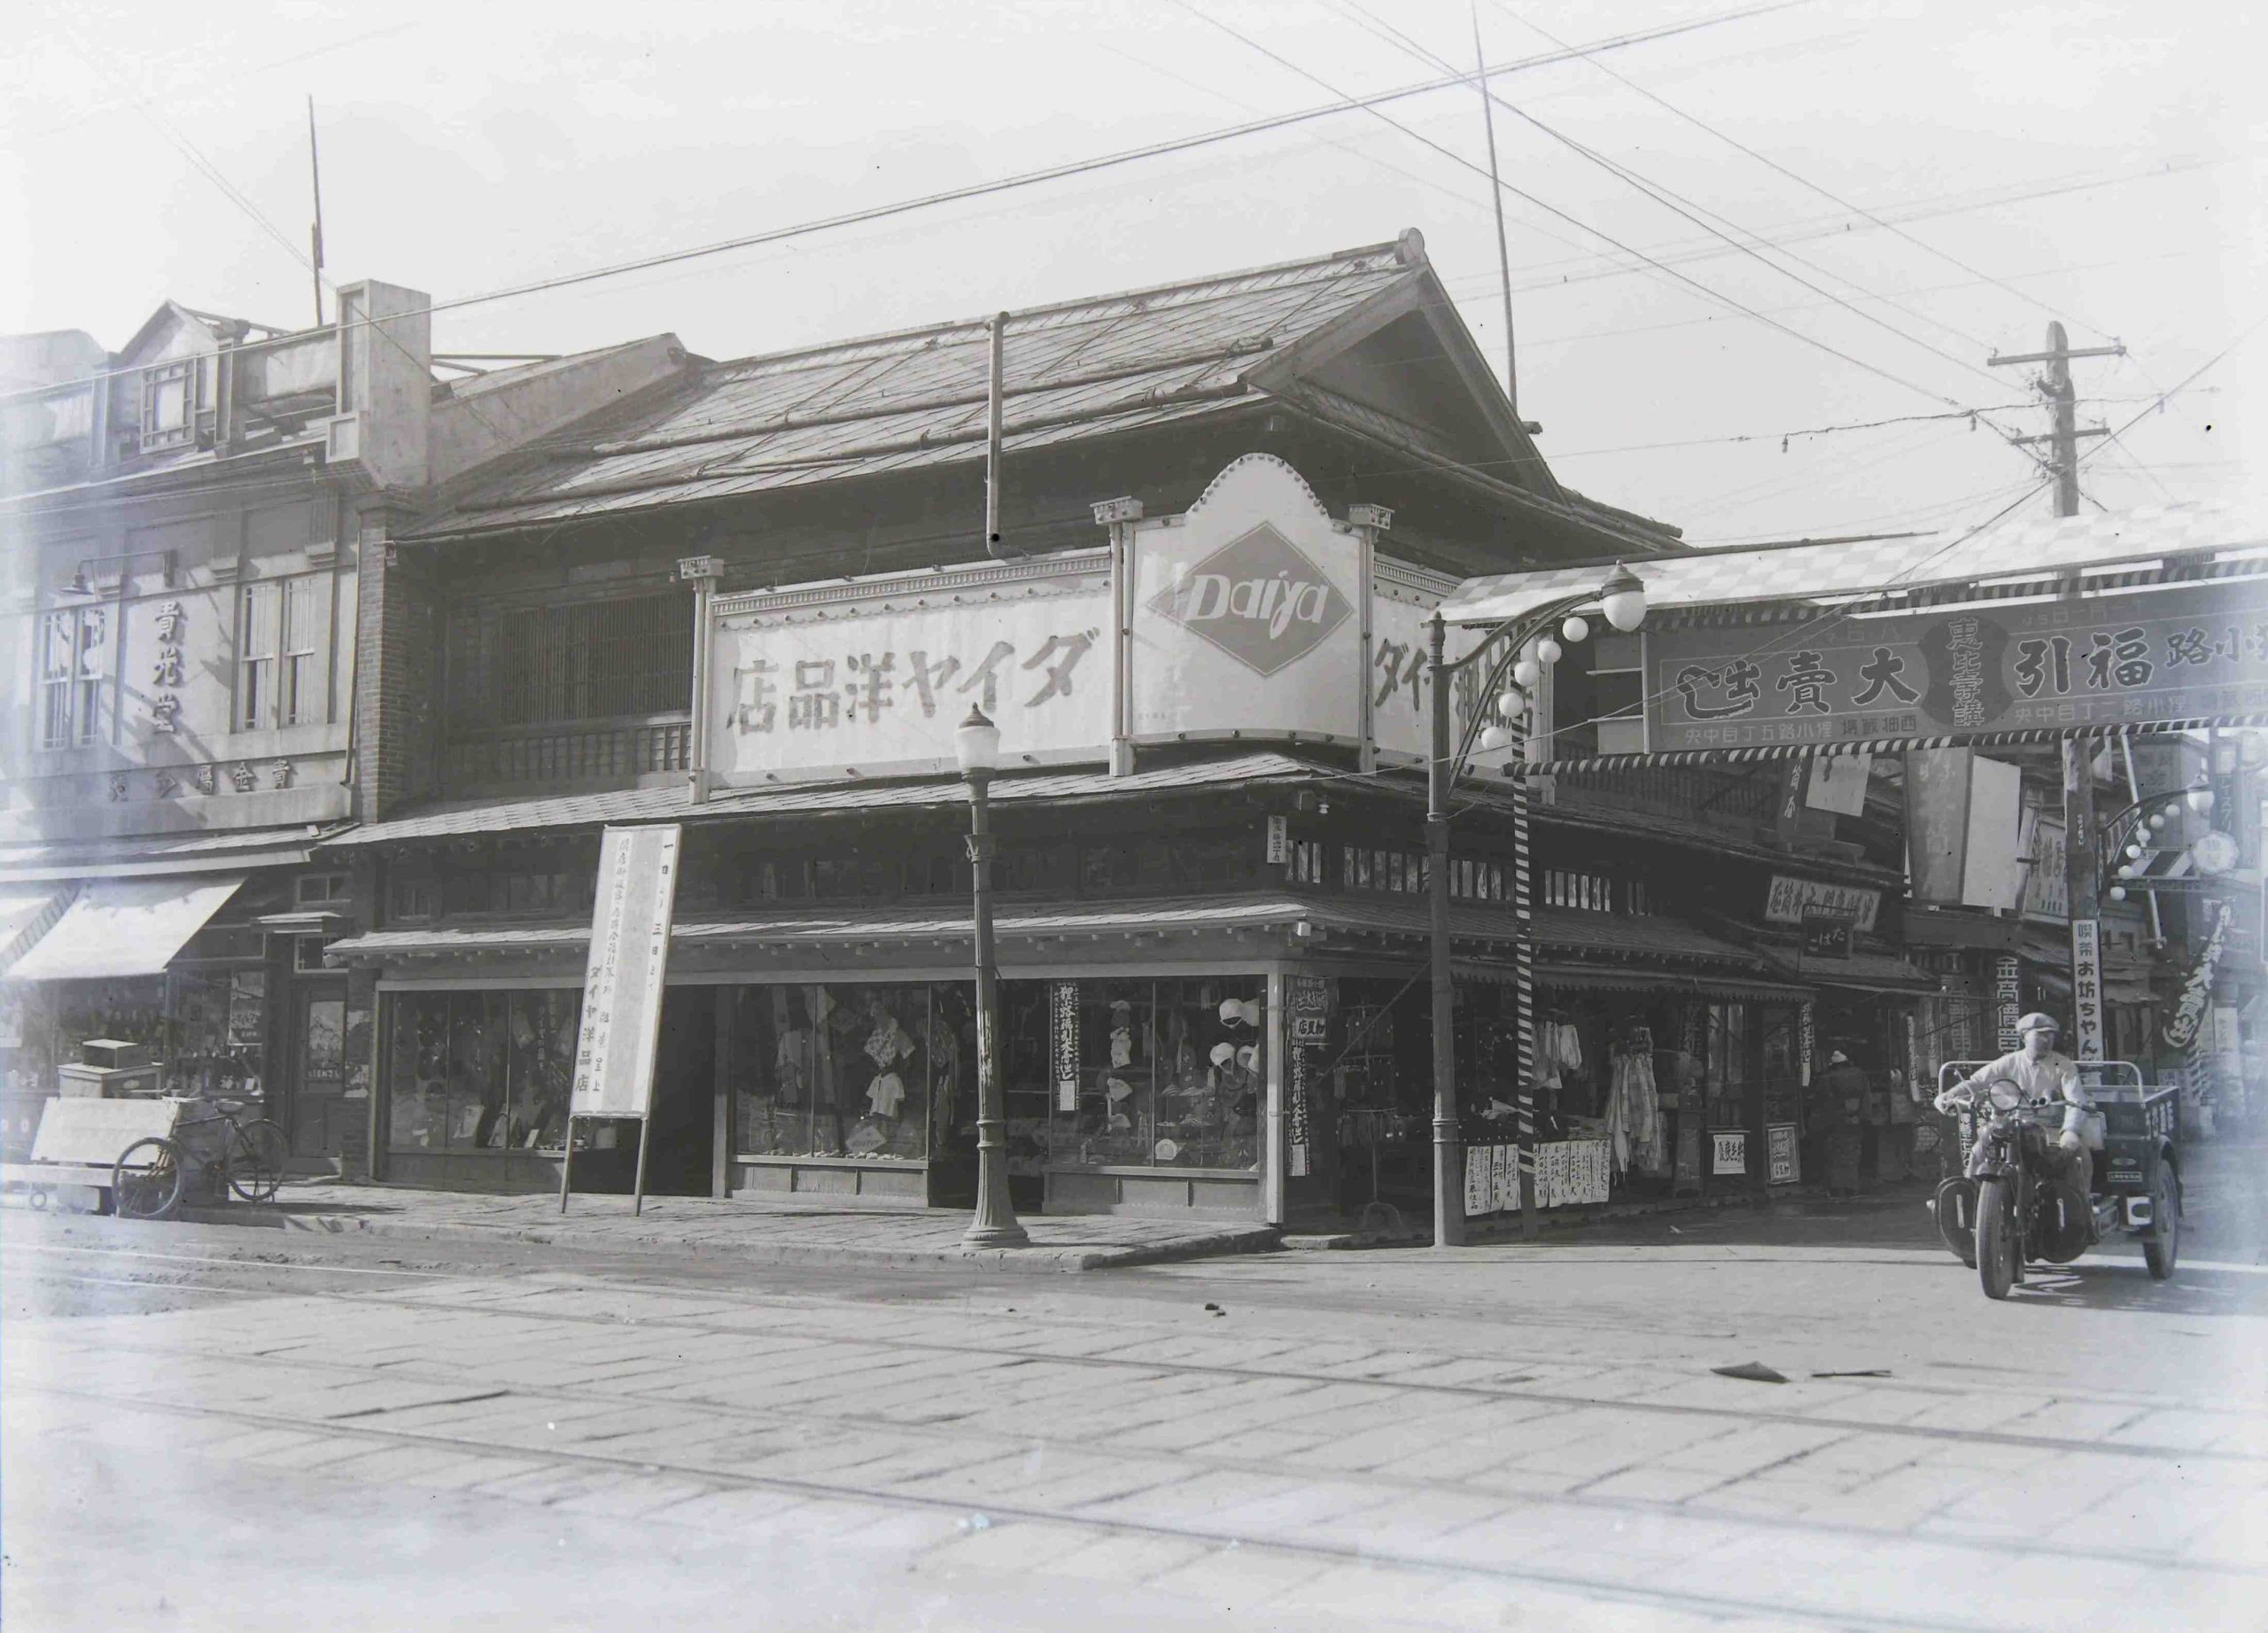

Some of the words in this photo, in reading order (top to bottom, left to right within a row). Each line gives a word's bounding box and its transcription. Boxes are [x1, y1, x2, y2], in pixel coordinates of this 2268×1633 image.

[1184, 570, 1329, 640] Daiya
[726, 626, 1101, 735] ダイヤ洋品店
